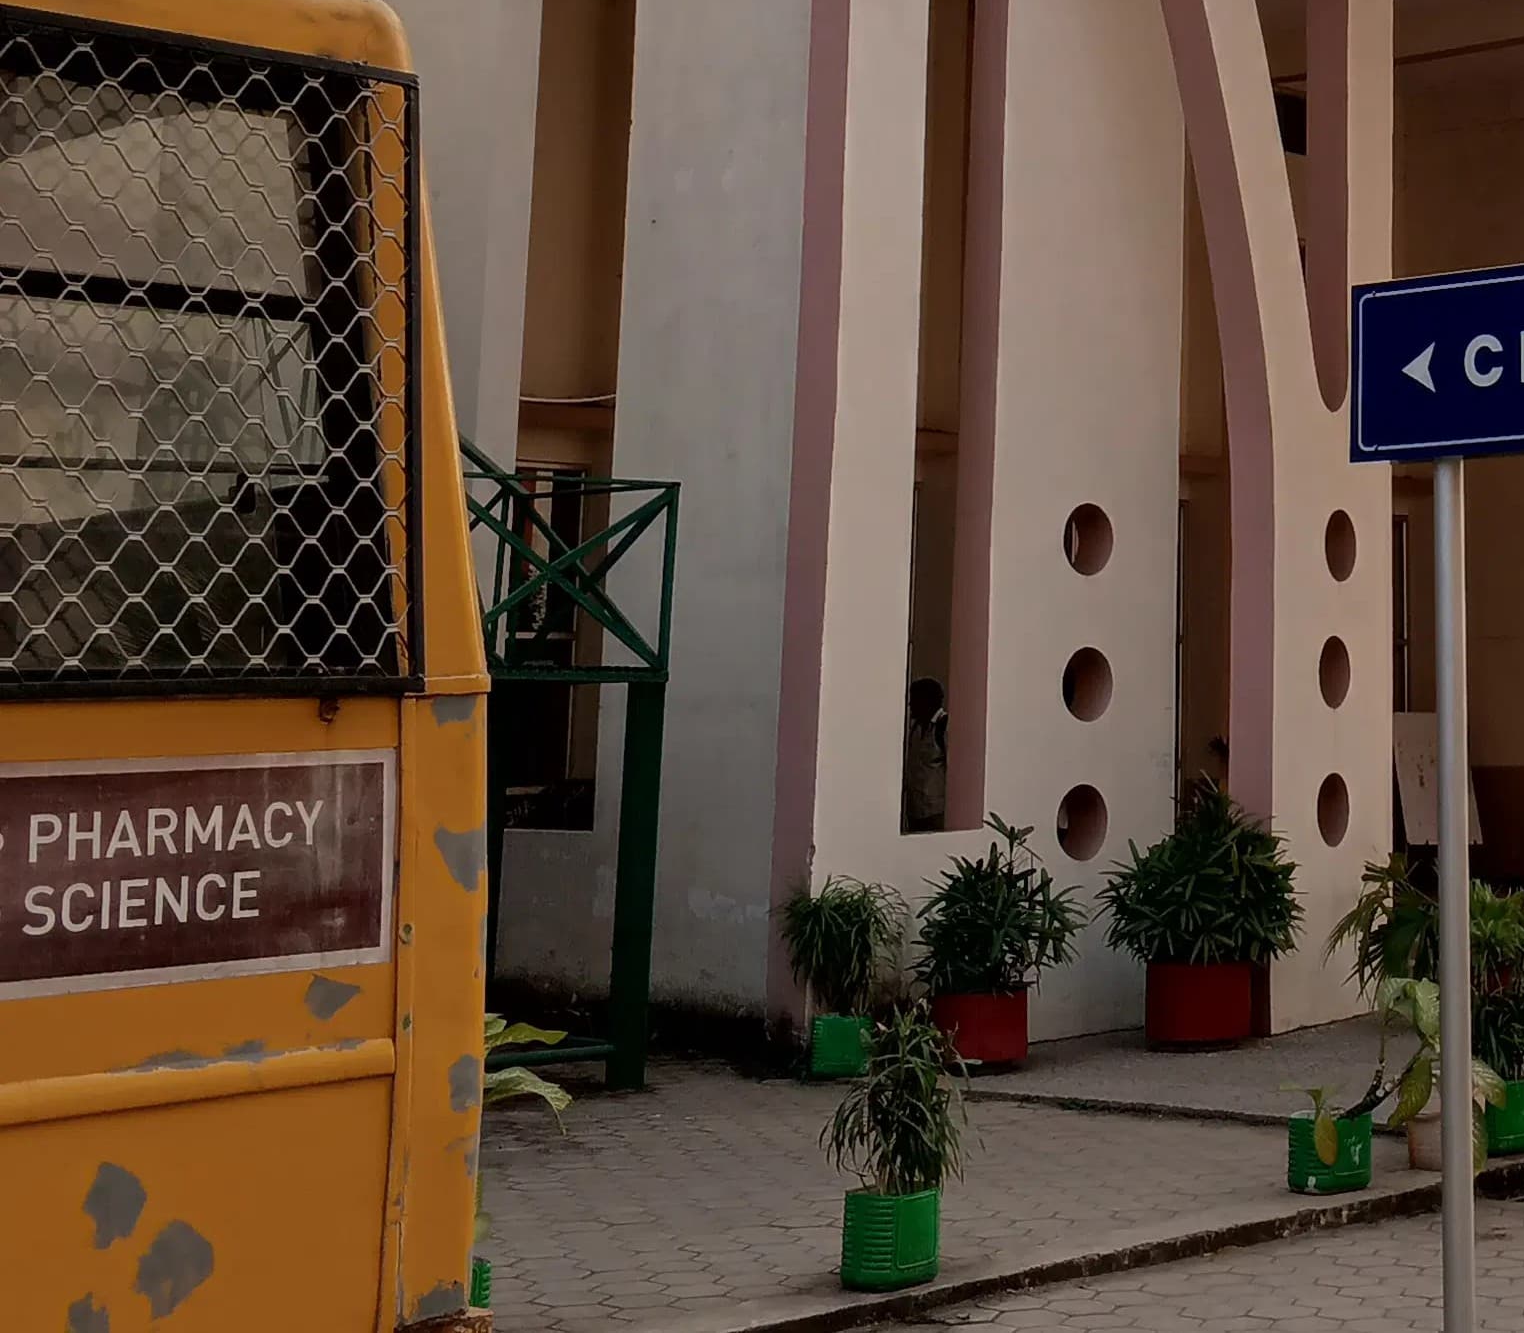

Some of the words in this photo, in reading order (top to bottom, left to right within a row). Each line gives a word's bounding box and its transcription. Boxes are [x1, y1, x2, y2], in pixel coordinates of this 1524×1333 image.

[1463, 333, 1504, 388] C
[28, 799, 324, 863] PHARMACY
[22, 870, 261, 936] SCIENCE
